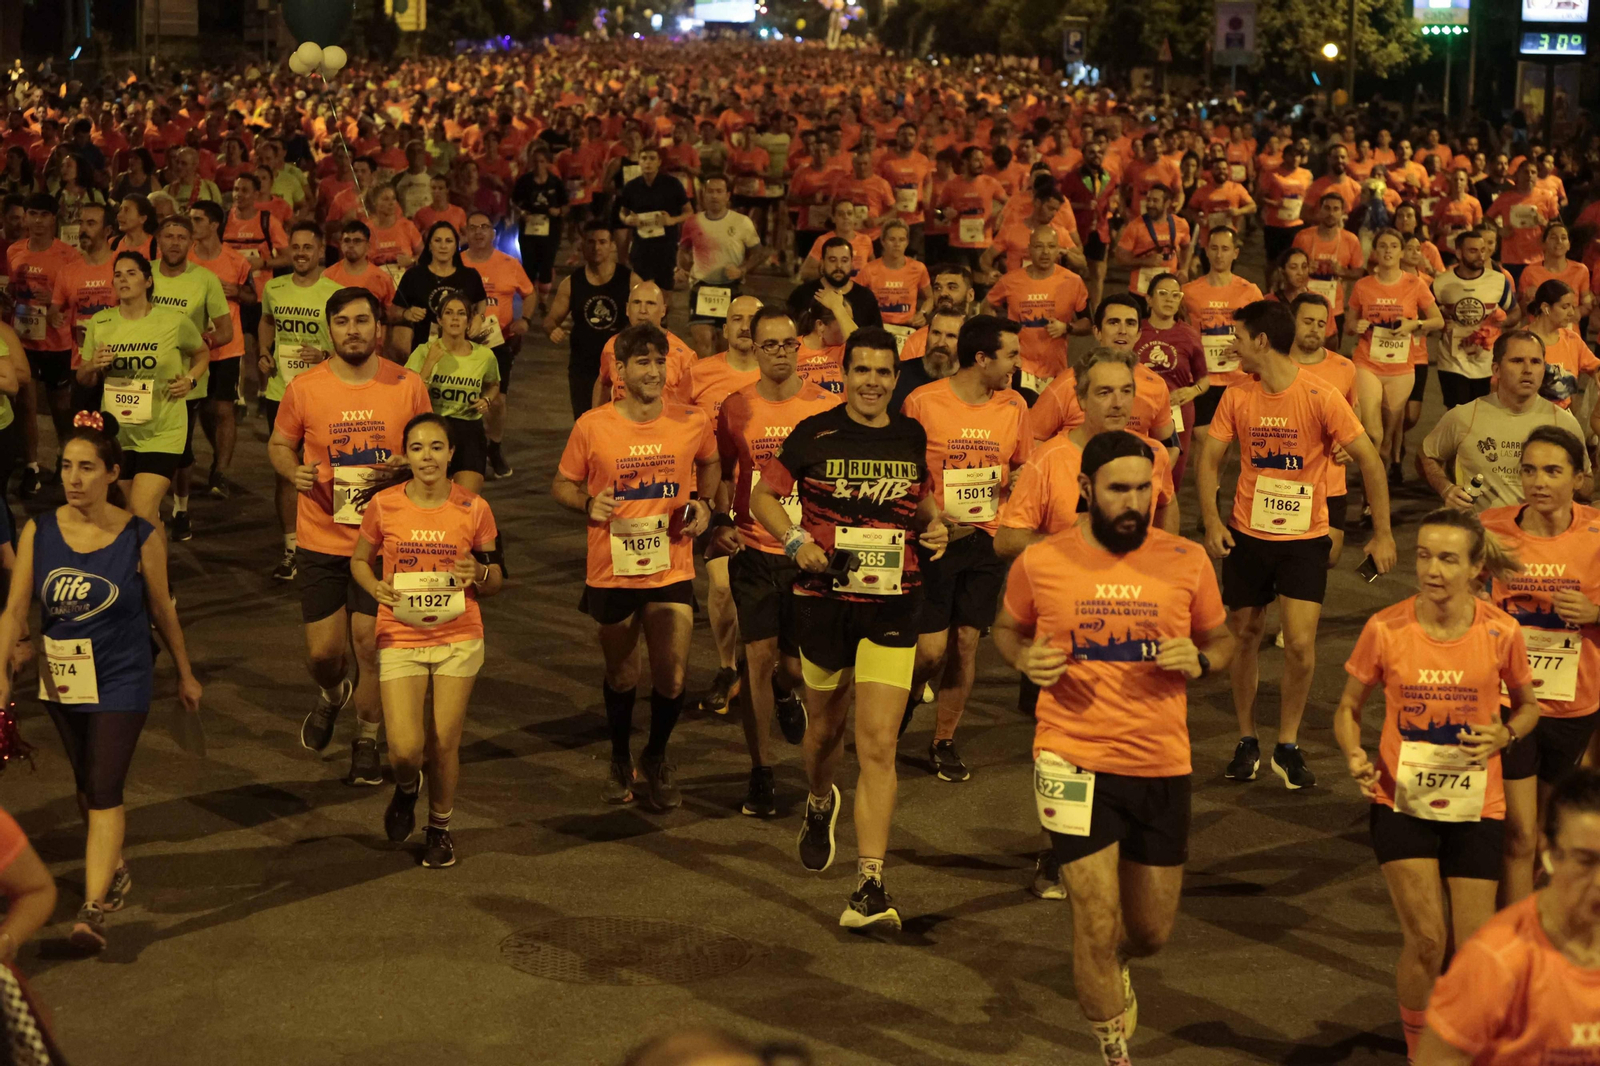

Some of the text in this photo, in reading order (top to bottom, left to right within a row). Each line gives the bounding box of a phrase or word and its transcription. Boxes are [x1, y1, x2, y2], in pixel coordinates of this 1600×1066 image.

[85, 280, 106, 288] XXXV
[1028, 293, 1049, 301] XXXV
[274, 306, 320, 317] RUNNING
[276, 319, 319, 334] sano
[1379, 340, 1404, 349] 20904
[107, 356, 157, 370] ano
[433, 374, 481, 387] RUNNING
[116, 394, 140, 405] 5092
[342, 410, 373, 421] XXXV
[1260, 417, 1288, 427] XXXV
[333, 426, 385, 434] GUADALQUIVIR
[961, 428, 991, 439] XXXV
[1252, 432, 1298, 440] GUADALQUIVIR
[629, 444, 662, 456] XXXV
[951, 444, 1000, 452] GUADALQUIVIR
[621, 459, 675, 469] GUADALQUIVIR
[851, 462, 917, 479] RUNNING
[832, 476, 912, 505] & MTB
[956, 487, 994, 500] 15013
[1264, 498, 1301, 512] 11862
[410, 530, 446, 542] XXXV
[622, 537, 660, 551] 11876
[400, 547, 457, 555] GUADALQUIVIR
[857, 551, 886, 567] 865
[1524, 563, 1566, 577] XXXV
[54, 576, 91, 602] life
[1095, 584, 1142, 599] XXXV
[408, 594, 451, 607] 11927
[1081, 608, 1159, 617] GUADALQUIVIR
[1417, 669, 1464, 685] XXXV
[1404, 691, 1478, 701] GUADALQUIVIR
[1415, 772, 1471, 790] 15774
